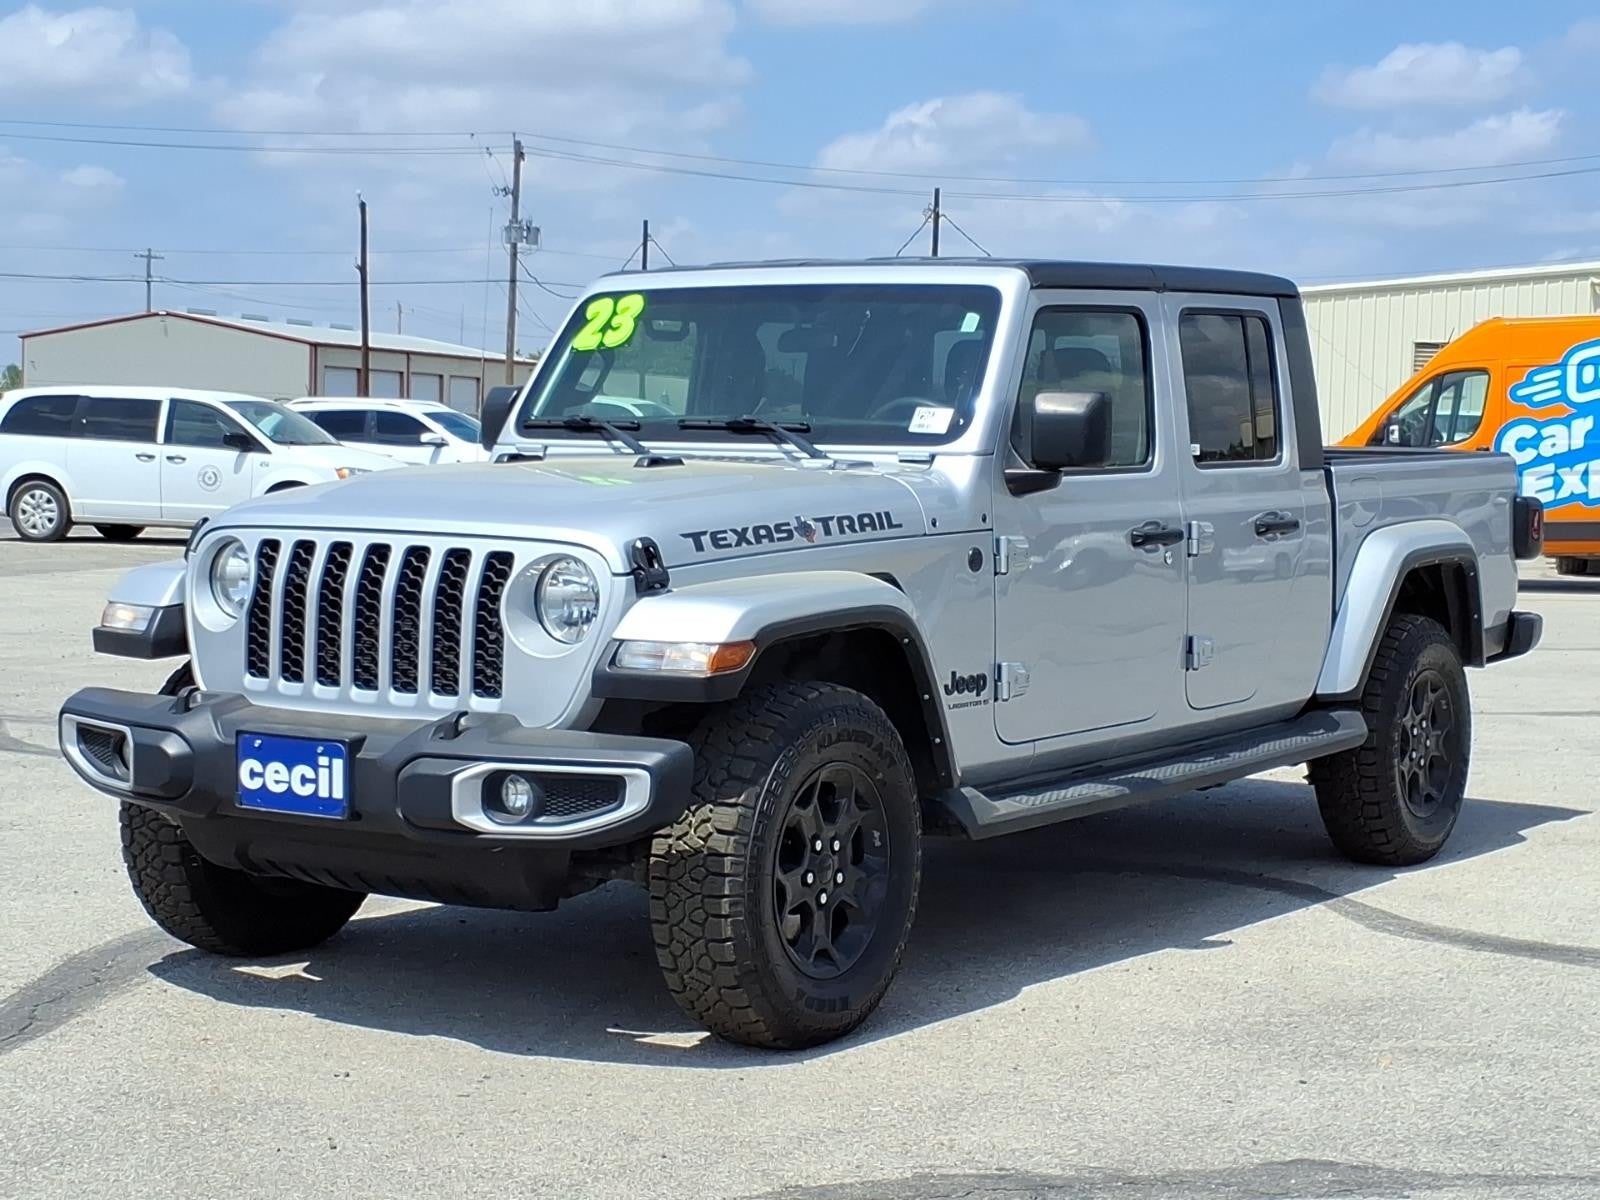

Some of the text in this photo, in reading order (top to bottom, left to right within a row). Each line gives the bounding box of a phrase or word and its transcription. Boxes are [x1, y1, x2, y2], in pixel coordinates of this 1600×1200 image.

[572, 293, 644, 350] 23
[1500, 415, 1594, 465] Car
[680, 511, 903, 553] TEXAS TRAIL
[943, 670, 988, 697] Jeep
[240, 755, 344, 799] cecil
